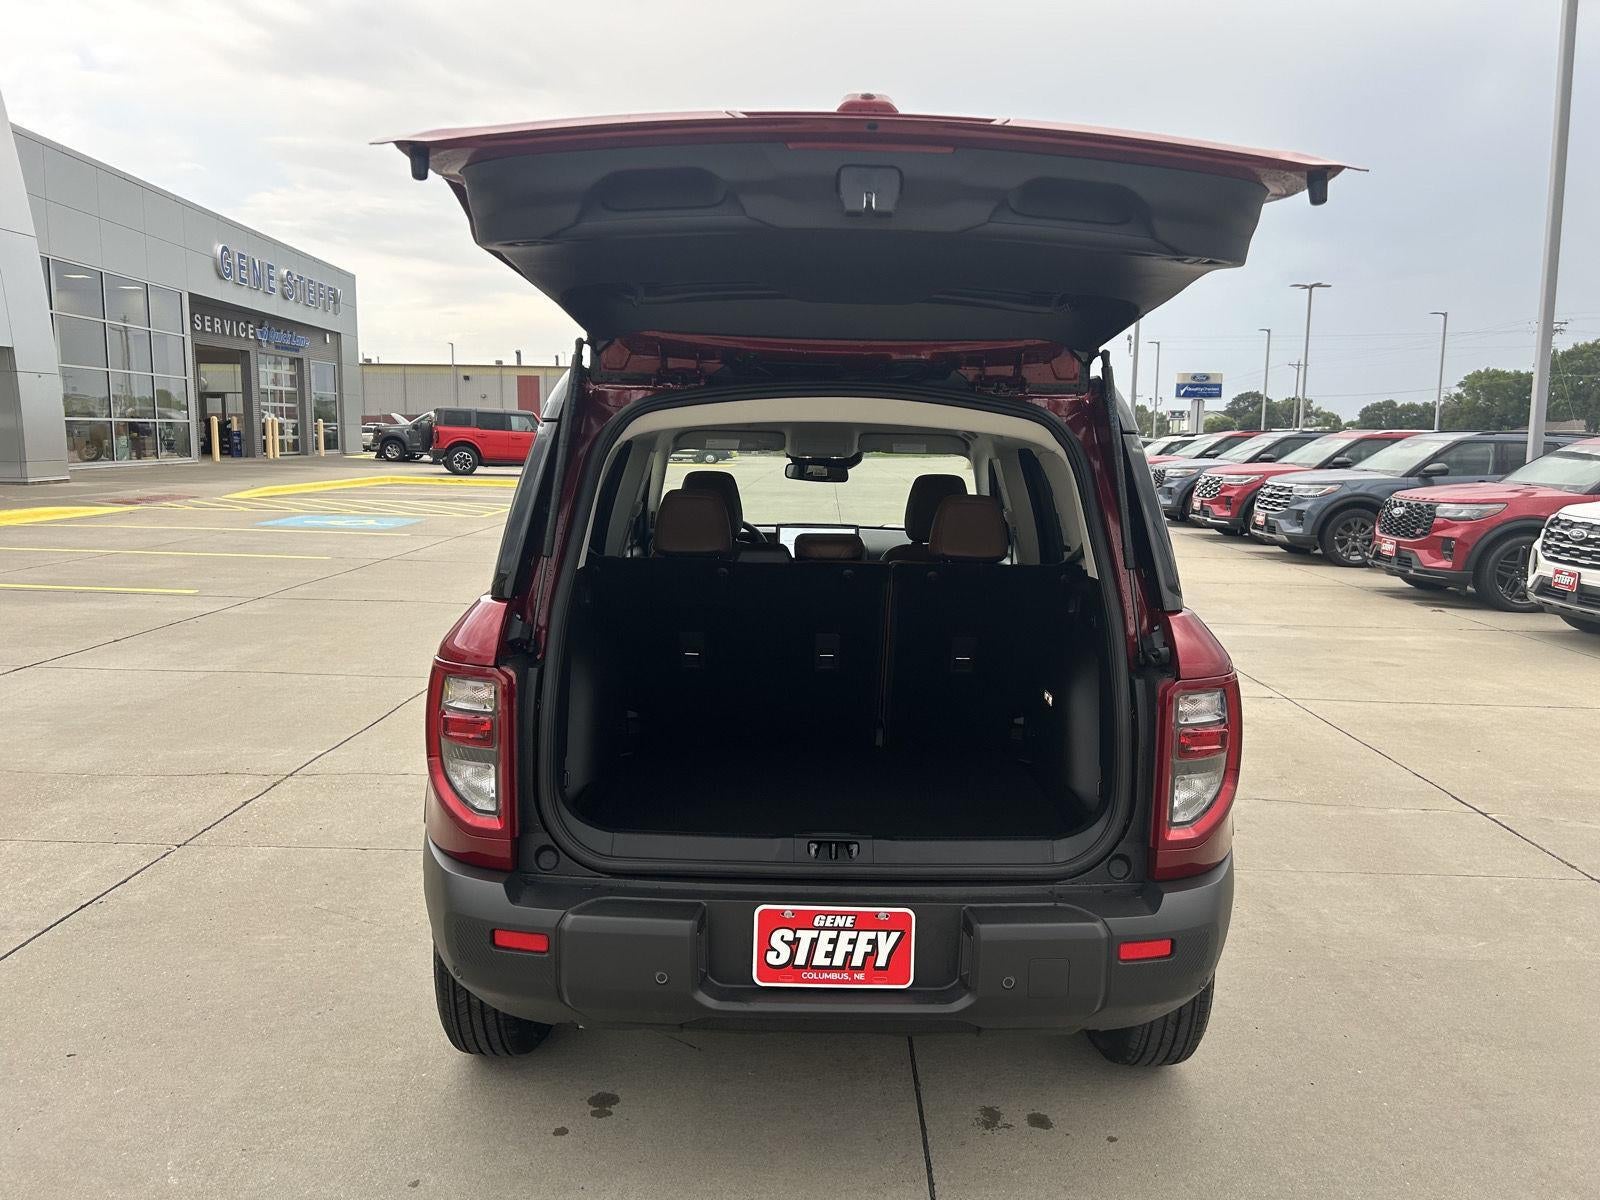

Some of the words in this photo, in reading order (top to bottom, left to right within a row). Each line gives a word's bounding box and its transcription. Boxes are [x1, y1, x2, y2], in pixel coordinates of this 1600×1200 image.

[216, 244, 276, 294] GENE
[281, 268, 343, 316] STEFFY
[194, 313, 255, 339] SERVICE
[1554, 573, 1576, 586] STEFFY
[813, 914, 857, 928] GENE
[765, 928, 904, 969] STEFFY
[801, 972, 852, 981] COLUMBUS,
